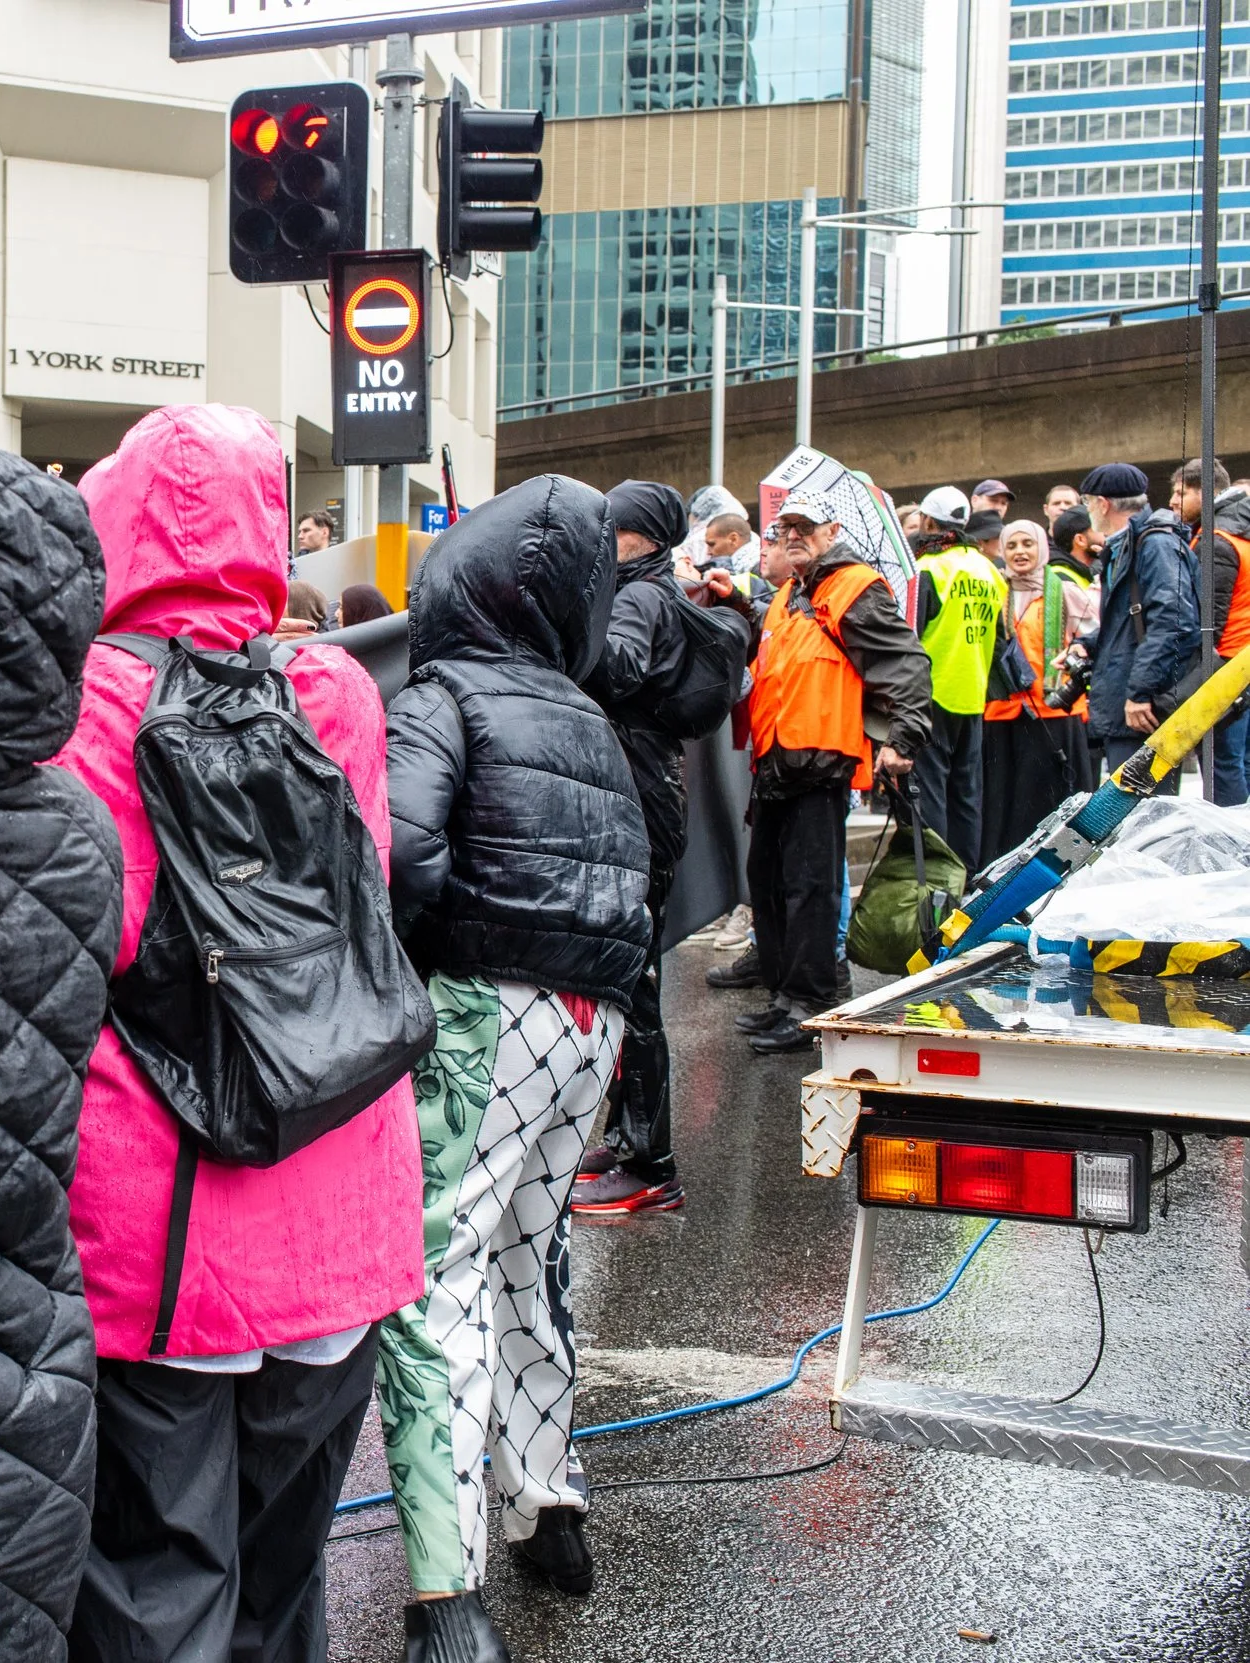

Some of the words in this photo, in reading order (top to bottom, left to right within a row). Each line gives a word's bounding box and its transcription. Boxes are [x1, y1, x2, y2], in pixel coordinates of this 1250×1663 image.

[9, 348, 18, 364] 1
[27, 350, 103, 371] YORK
[112, 357, 205, 379] STREET
[358, 359, 404, 387] NO
[346, 391, 417, 413] ENTRY
[428, 509, 444, 525] For
